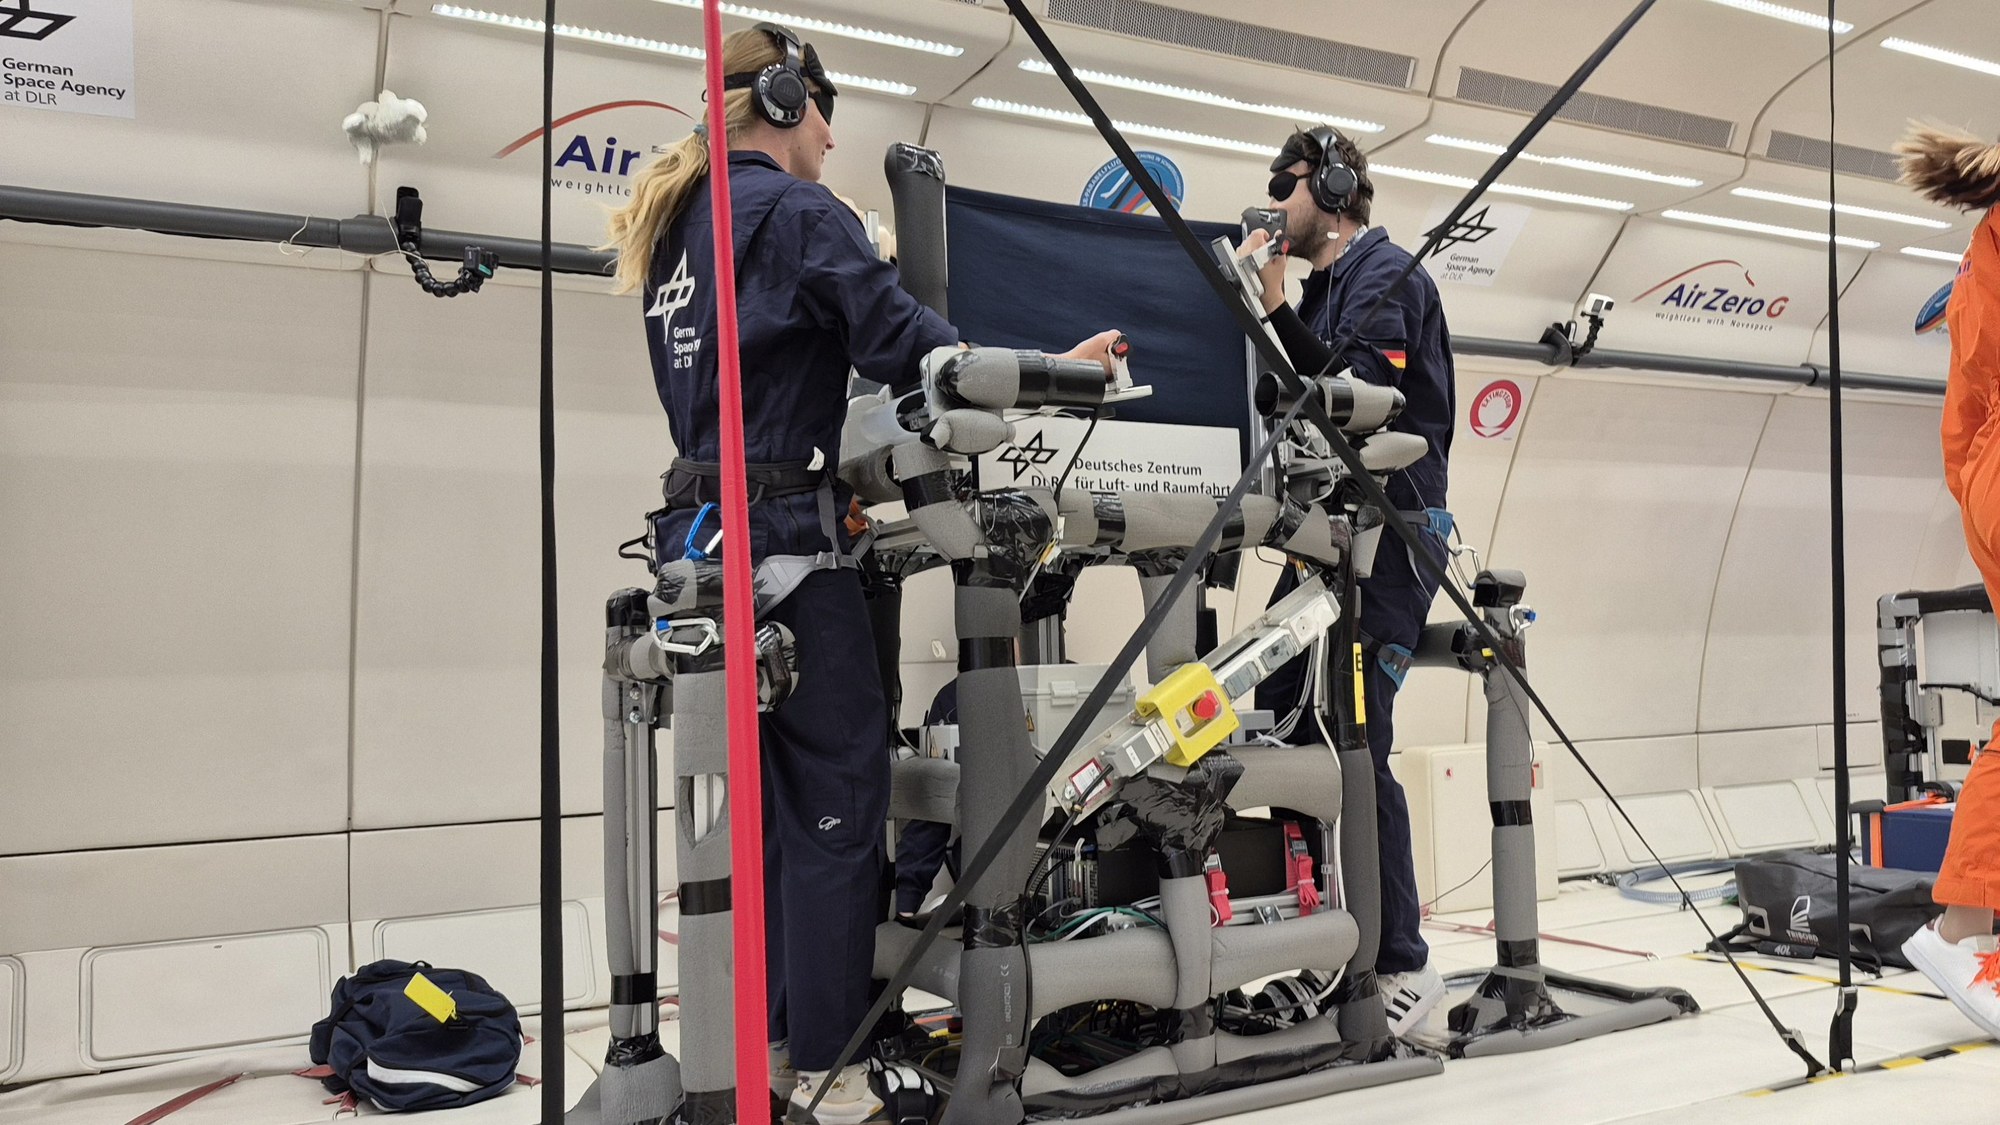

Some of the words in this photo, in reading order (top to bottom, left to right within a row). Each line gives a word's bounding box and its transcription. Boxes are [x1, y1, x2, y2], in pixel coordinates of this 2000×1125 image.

[2, 57, 74, 77] German
[3, 73, 56, 89] Space
[61, 80, 126, 100] Agency
[4, 90, 20, 102] at
[25, 90, 58, 106] DLR
[554, 134, 641, 177] Air
[551, 178, 632, 197] weightle
[1450, 252, 1480, 264] German
[1444, 261, 1467, 272] Space
[1467, 264, 1496, 277] Agency
[1655, 311, 1702, 322] weightless
[1706, 317, 1725, 326] with
[1729, 319, 1774, 332] Novespace
[673, 357, 683, 369] at
[1074, 458, 1143, 473] Deutsches
[1147, 461, 1203, 476] Zentrum
[1074, 476, 1095, 490] für
[1099, 477, 1130, 491] Luft-
[1134, 479, 1159, 493] und
[1163, 481, 1232, 497] Raumfahrt
[1774, 944, 1791, 956] 40L
